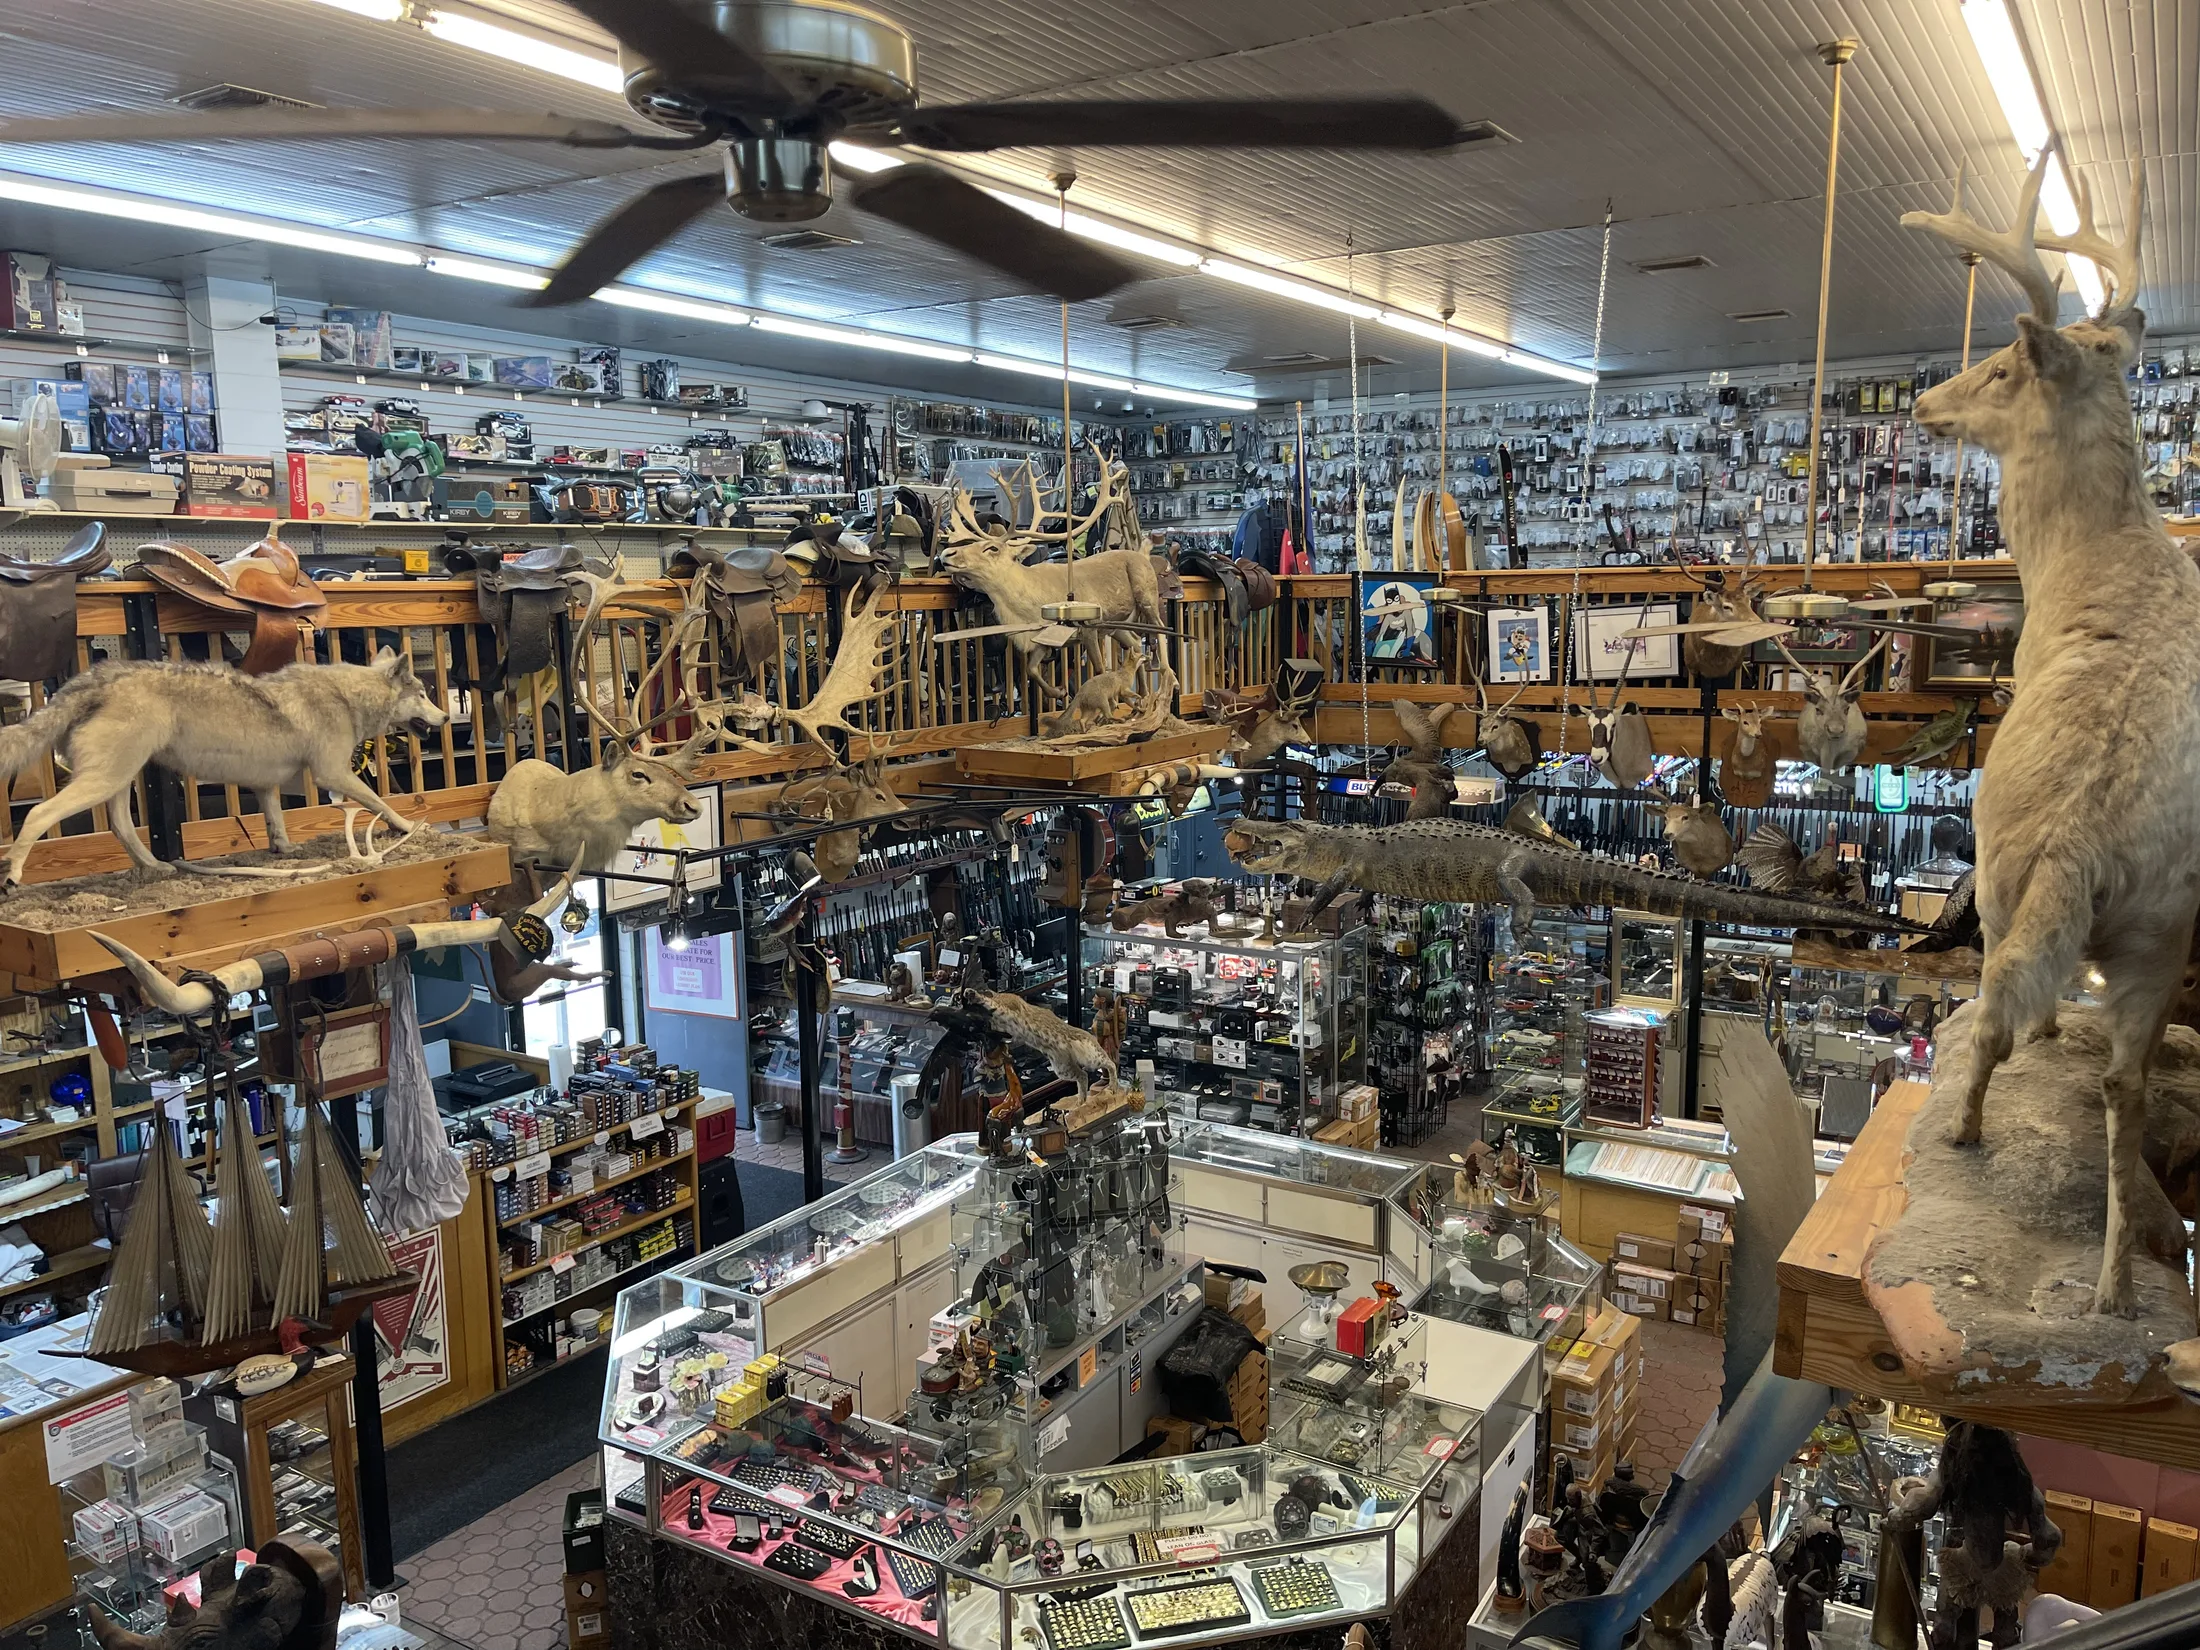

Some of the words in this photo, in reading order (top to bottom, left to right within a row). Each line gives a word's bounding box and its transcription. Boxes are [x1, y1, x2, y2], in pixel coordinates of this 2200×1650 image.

[150, 461, 166, 473] Powder
[167, 462, 184, 475] Coating
[189, 462, 217, 475] Powder
[219, 463, 246, 478] Coating
[247, 465, 273, 479] System
[294, 466, 306, 506] Sunbeam
[661, 952, 675, 960] OUR
[675, 954, 692, 962] BEST
[700, 948, 713, 956] FOR
